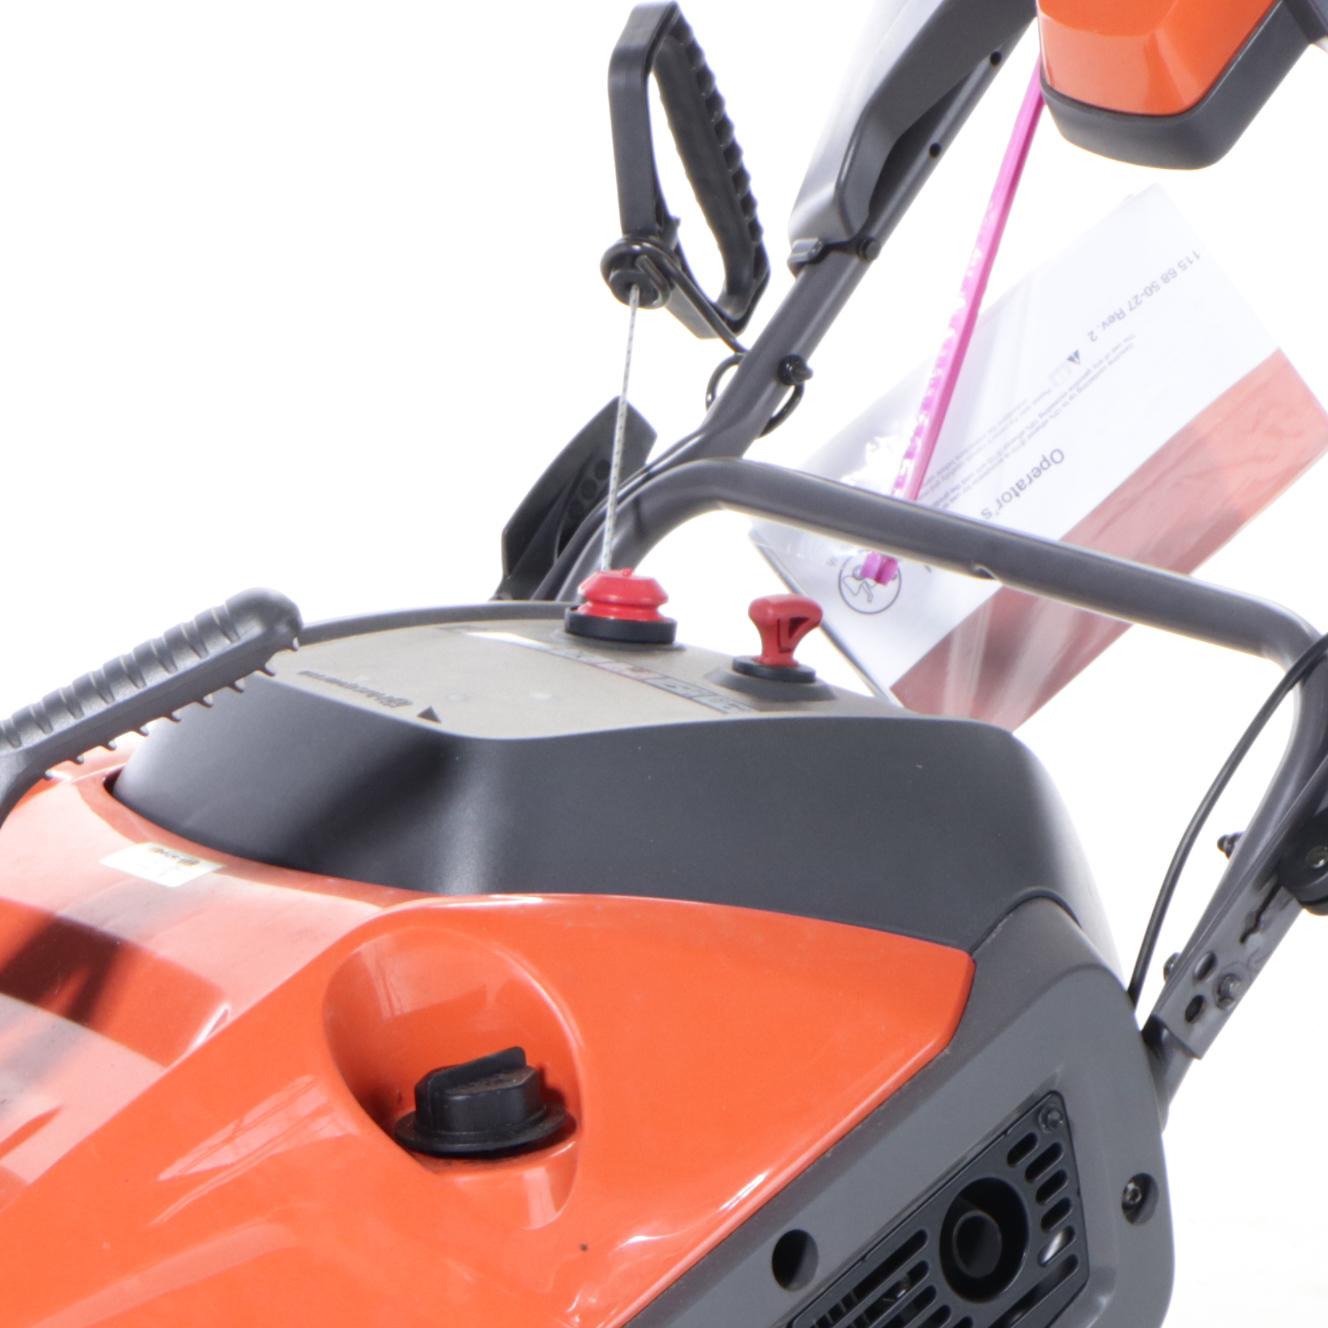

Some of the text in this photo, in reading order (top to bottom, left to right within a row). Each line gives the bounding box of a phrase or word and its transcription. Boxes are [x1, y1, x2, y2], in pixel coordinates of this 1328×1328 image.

[1177, 249, 1201, 271] 115
[1128, 280, 1161, 312] 50-27
[1096, 307, 1127, 330] Rev.
[1087, 329, 1098, 342] 2
[980, 448, 1065, 519] Operator's
